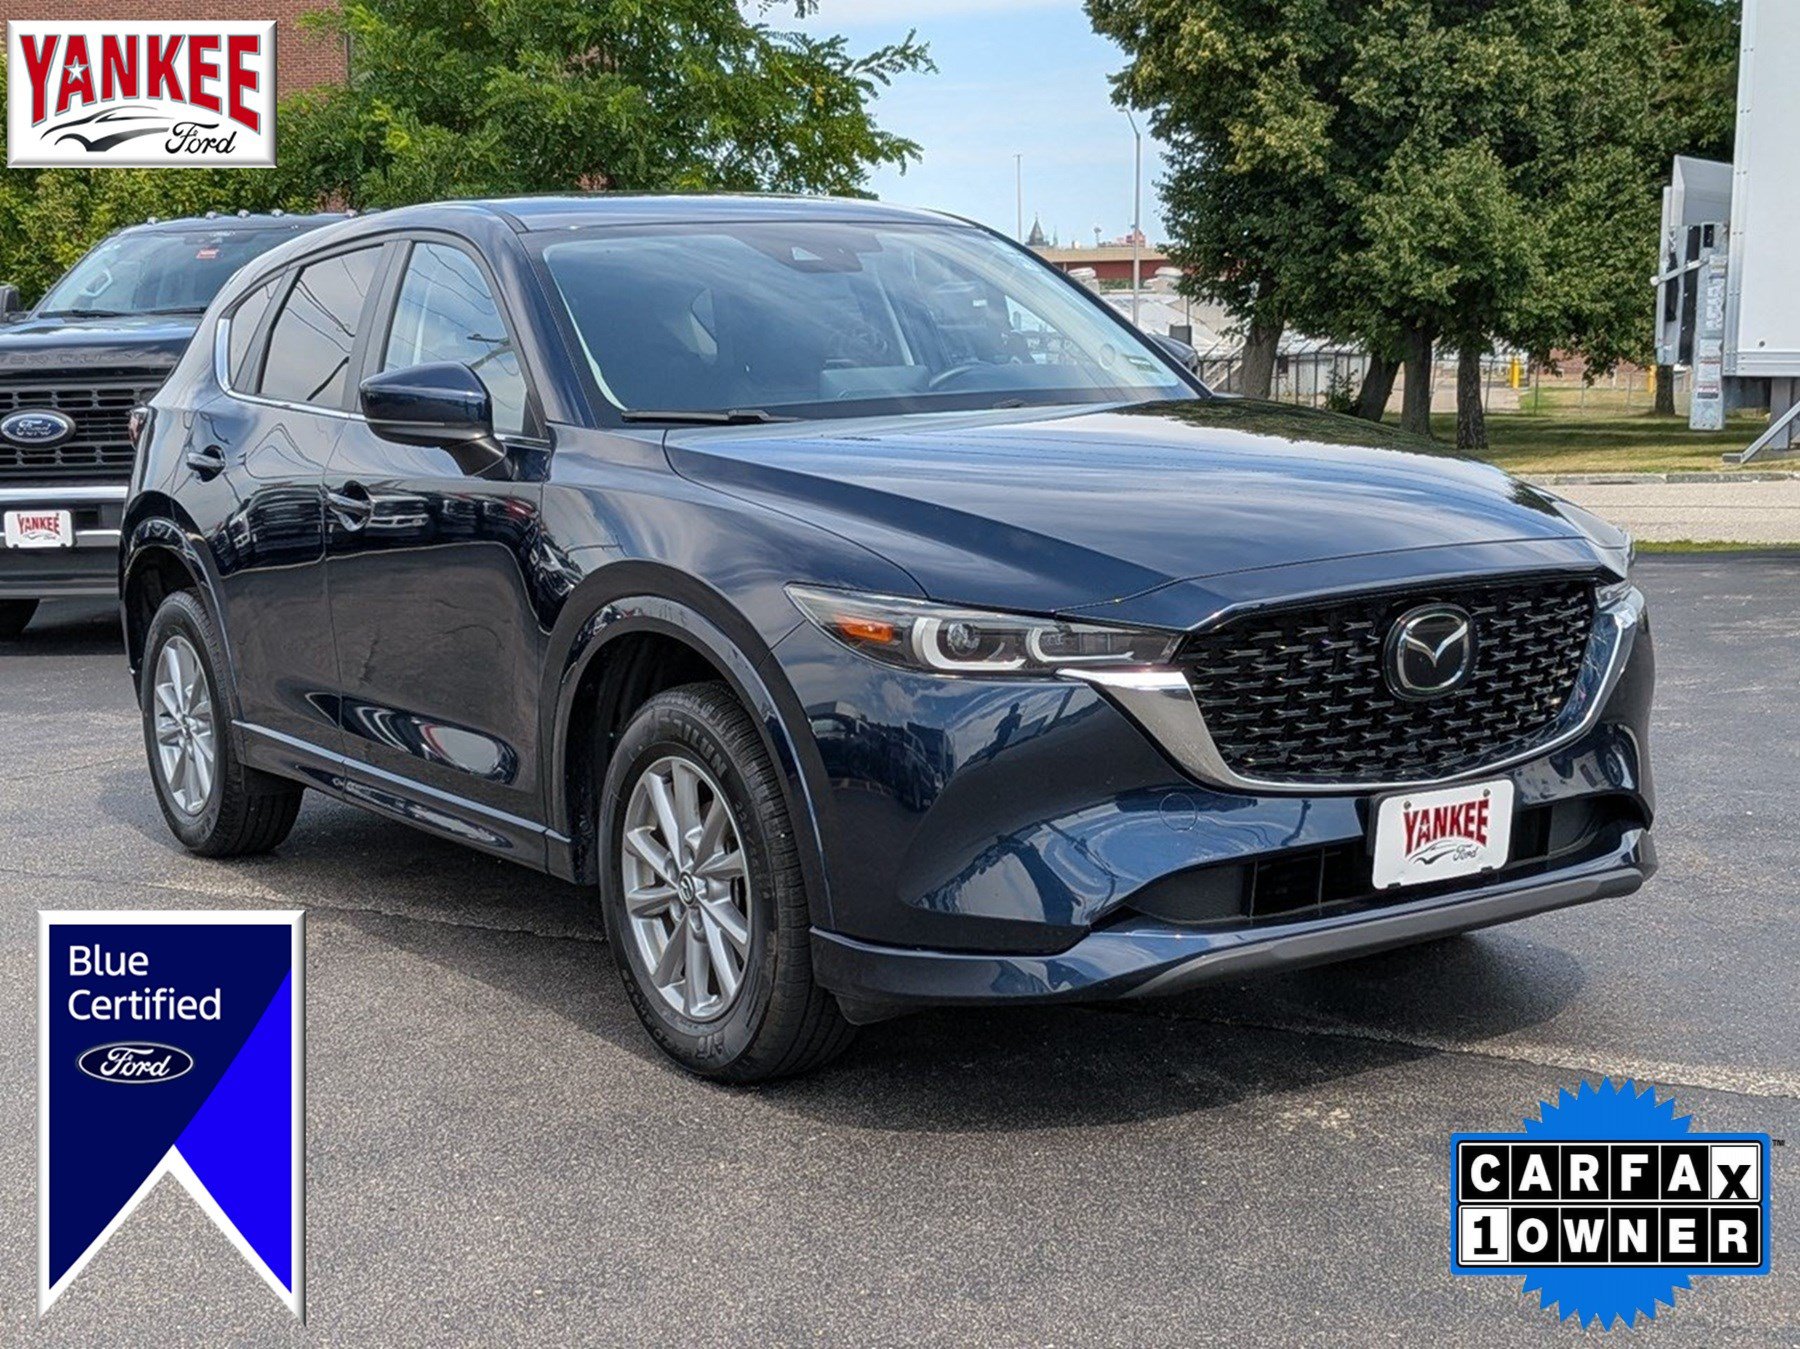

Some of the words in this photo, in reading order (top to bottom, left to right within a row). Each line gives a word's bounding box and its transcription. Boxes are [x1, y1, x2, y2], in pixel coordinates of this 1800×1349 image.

[16, 419, 52, 436] Ford
[17, 515, 60, 535] YANKEE
[1403, 798, 1490, 858] YANKEE
[1452, 844, 1479, 862] Ford
